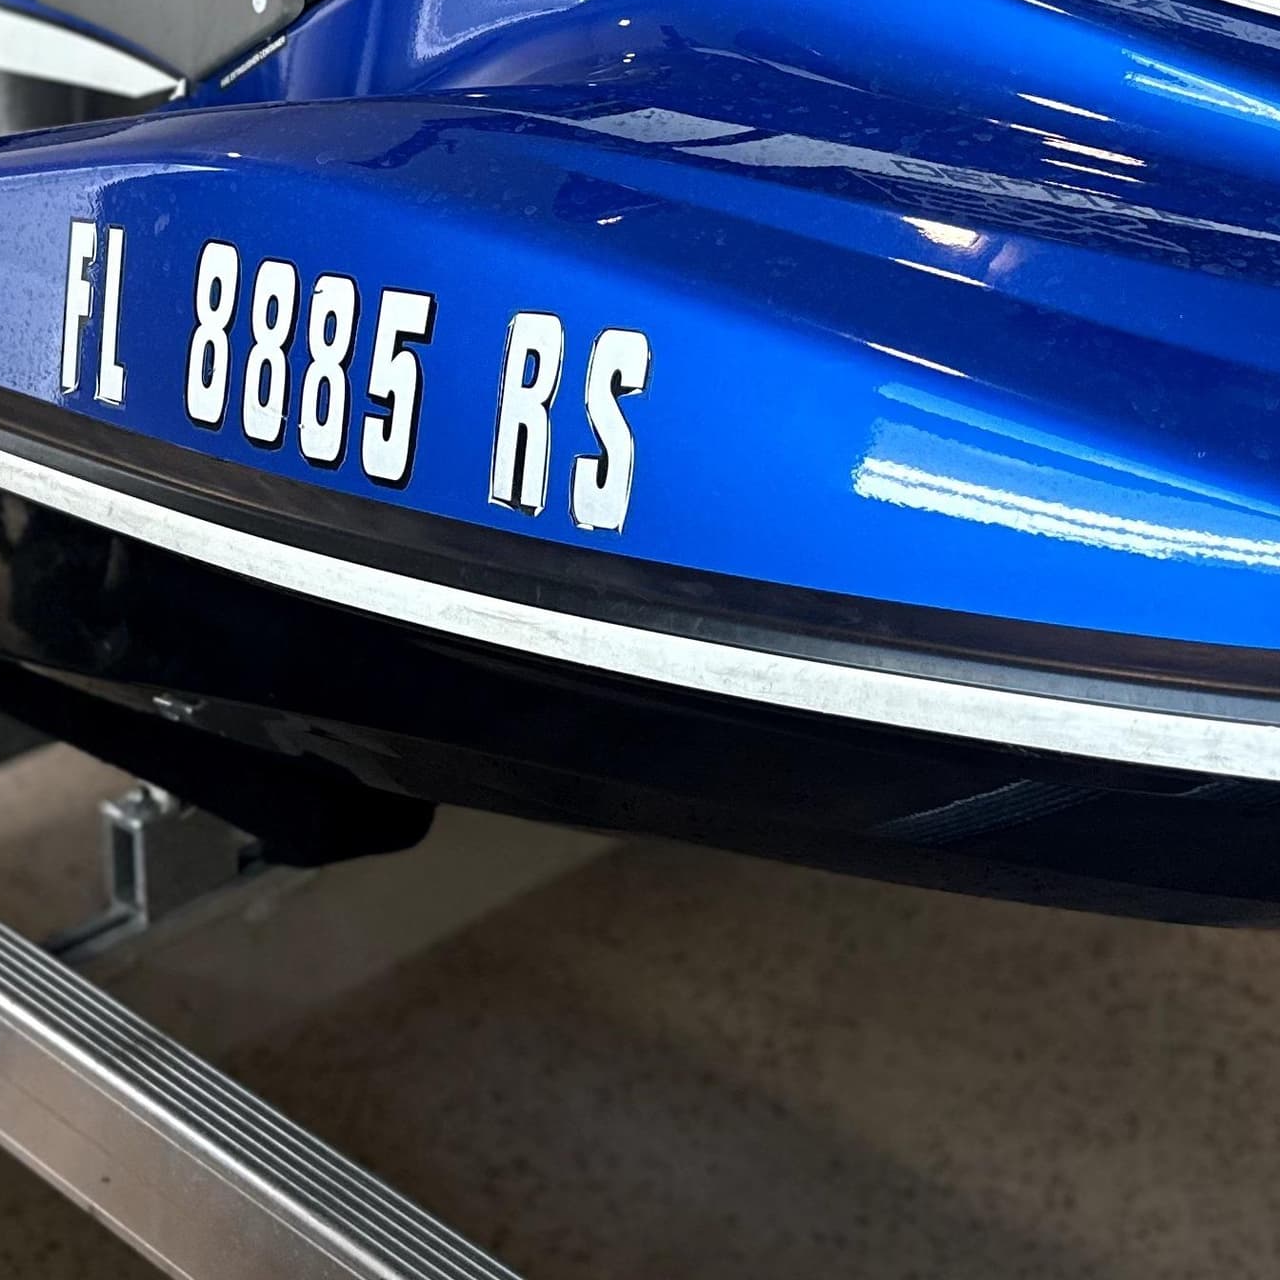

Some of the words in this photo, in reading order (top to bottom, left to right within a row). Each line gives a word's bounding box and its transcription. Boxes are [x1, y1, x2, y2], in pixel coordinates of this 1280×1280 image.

[60, 219, 126, 405] FL
[184, 238, 437, 489] 8885
[488, 310, 652, 535] RS
